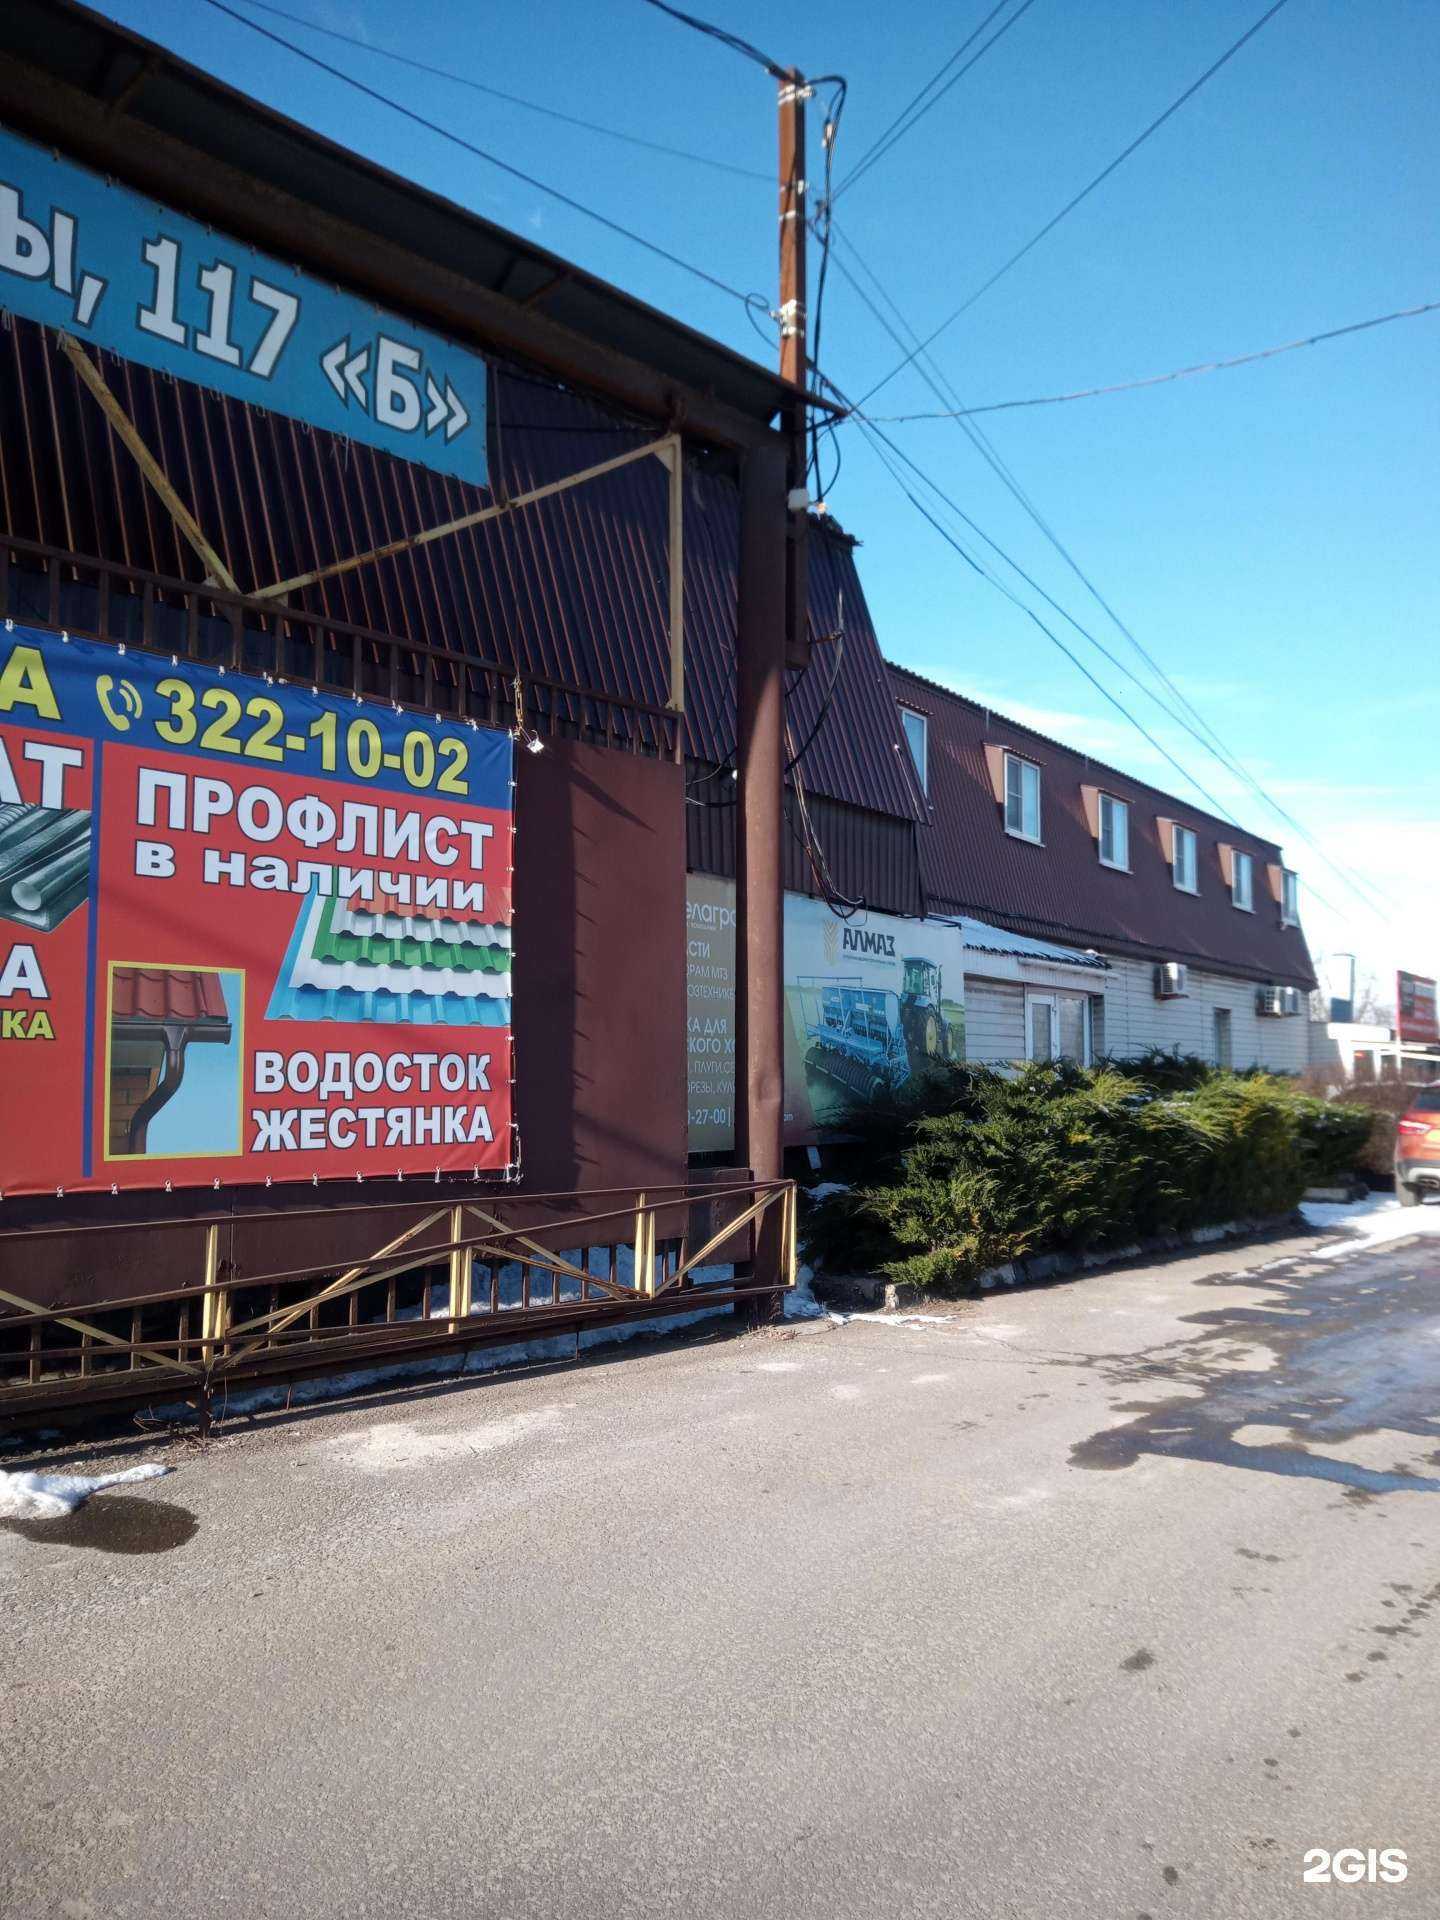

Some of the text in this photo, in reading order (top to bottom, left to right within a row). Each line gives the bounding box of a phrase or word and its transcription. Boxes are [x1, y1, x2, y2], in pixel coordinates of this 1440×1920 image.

[138, 235, 300, 379] 117
[321, 333, 470, 444] «Б»
[154, 679, 469, 795] 322-10-02
[138, 767, 494, 870] ПРОФЛИСТ
[135, 840, 485, 912] в наличии
[687, 940, 711, 958] СТИ
[842, 927, 896, 957] АЛМАЗ
[0, 944, 51, 1000] А
[0, 1009, 56, 1040] КА
[687, 1036, 721, 1054] КОГО
[703, 1017, 727, 1036] ДЛЯ
[254, 1051, 492, 1100] ВОДОСТОК
[251, 1105, 494, 1152] ЖЕСТЯНКА
